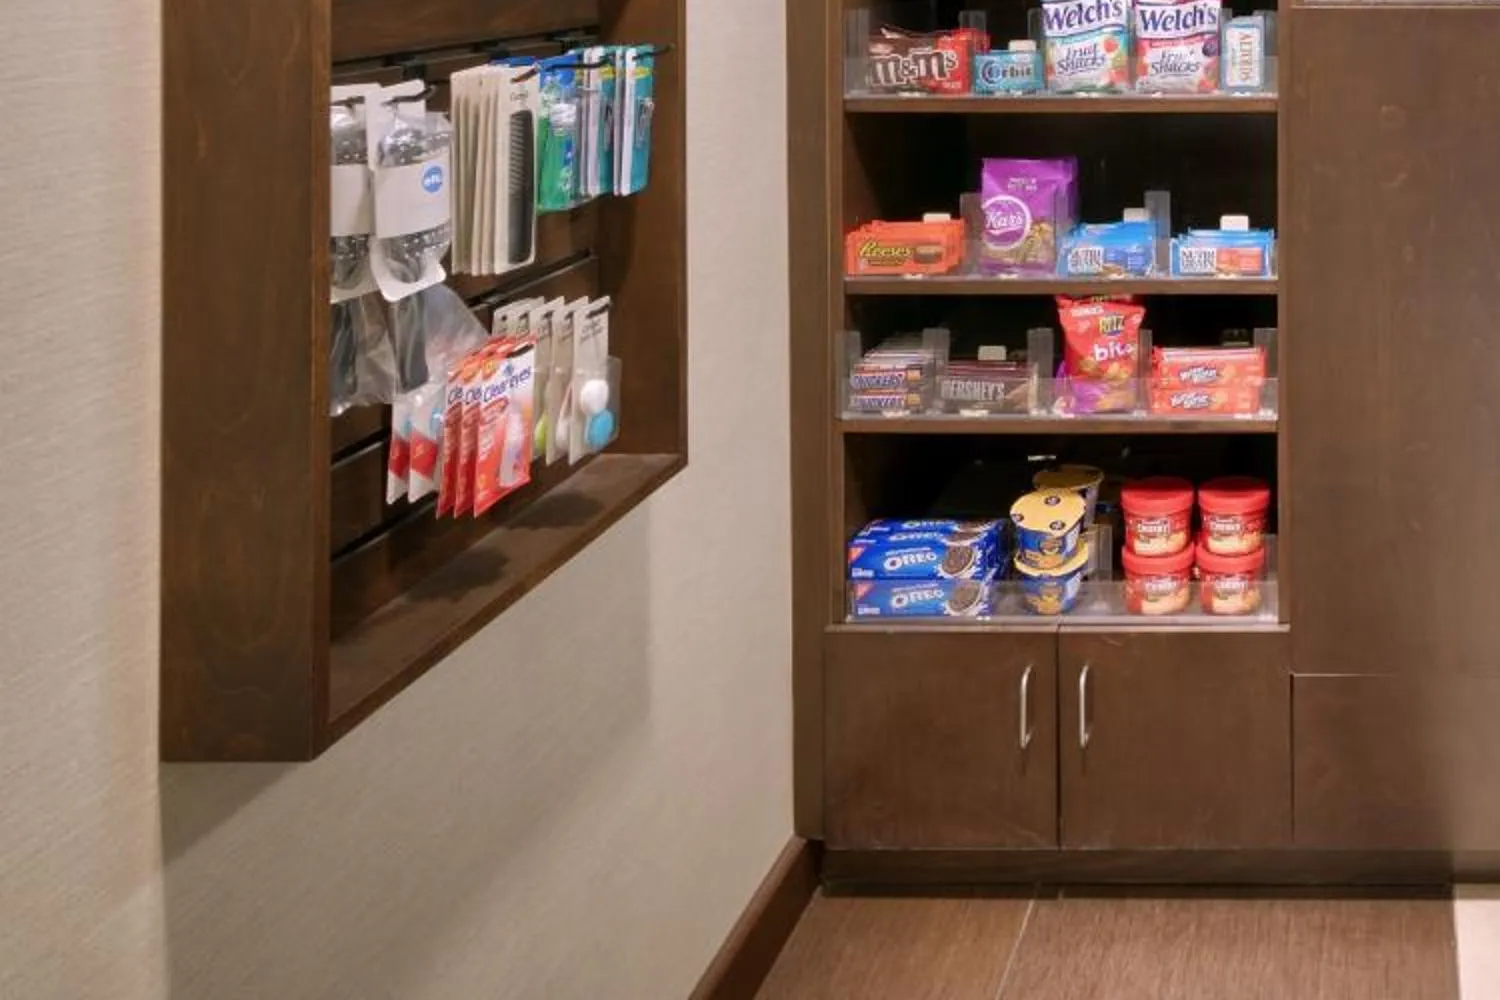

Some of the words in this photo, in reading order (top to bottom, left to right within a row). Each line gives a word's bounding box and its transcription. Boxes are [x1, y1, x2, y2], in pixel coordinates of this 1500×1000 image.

[1139, 3, 1218, 32] Welch's
[883, 551, 938, 571] OREO
[890, 588, 945, 609] OREO
